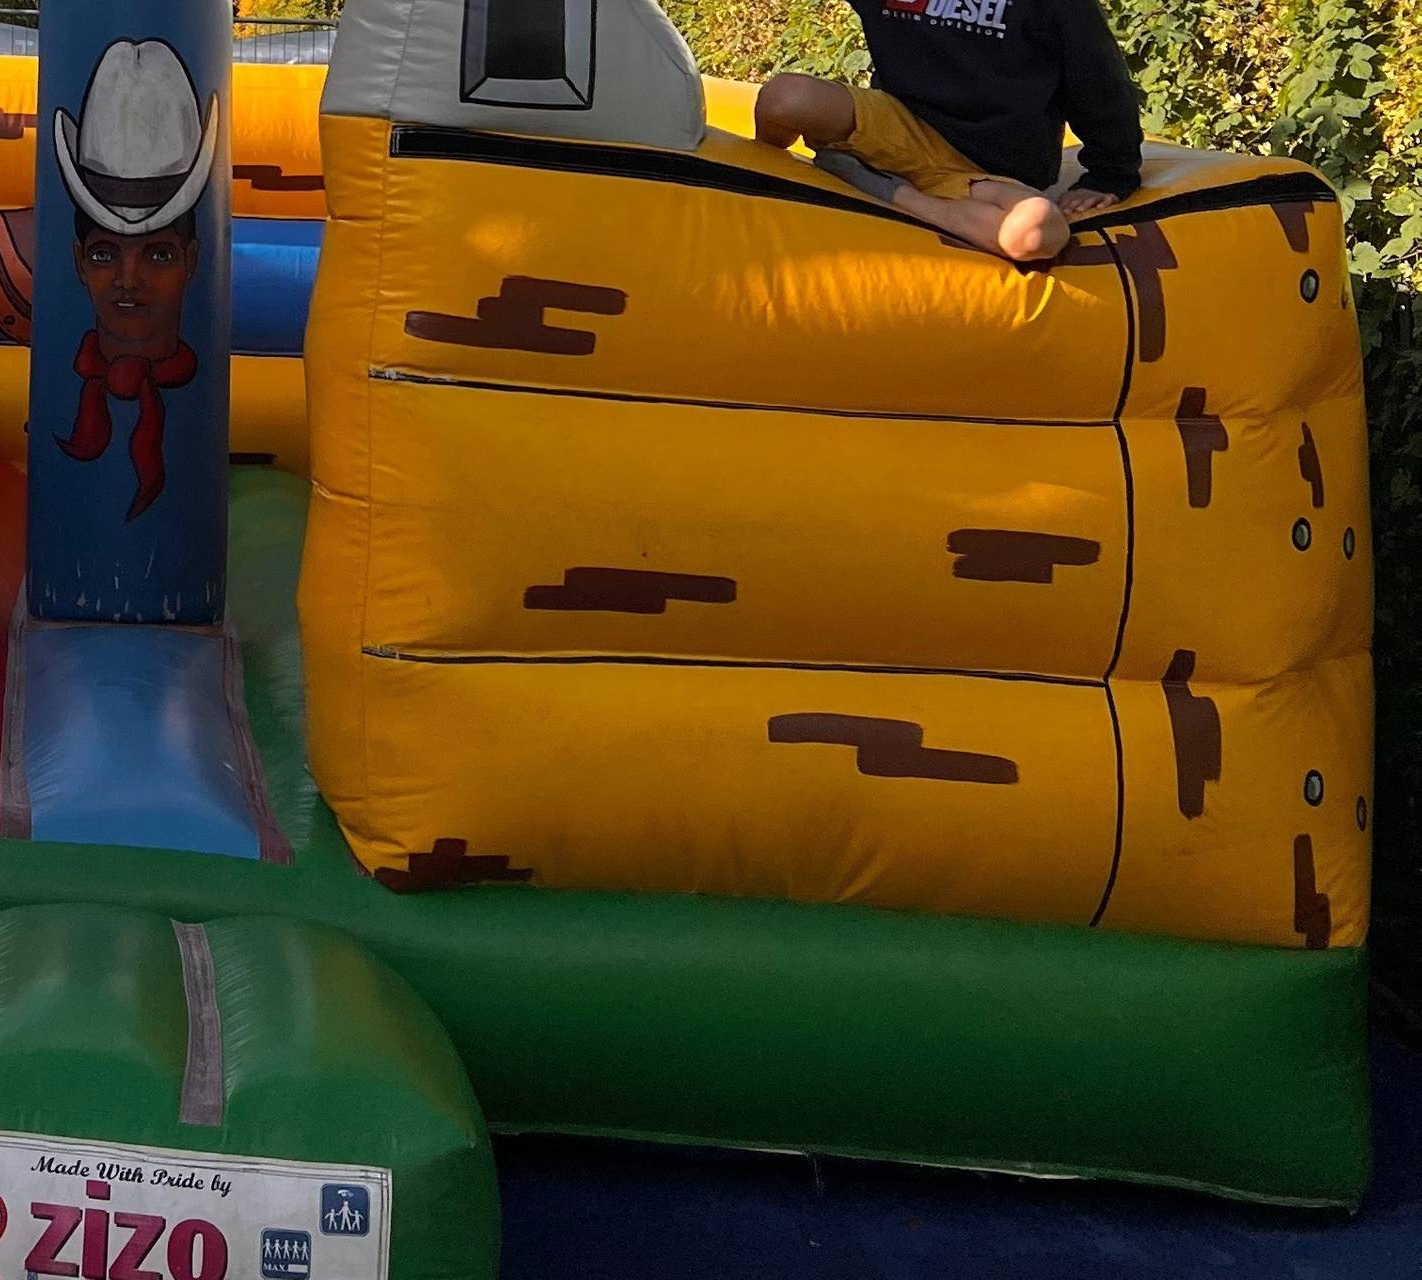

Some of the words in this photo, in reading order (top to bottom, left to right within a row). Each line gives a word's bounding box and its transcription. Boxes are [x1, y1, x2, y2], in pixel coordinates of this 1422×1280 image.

[31, 1156, 90, 1177] Made
[96, 1162, 145, 1184] With
[150, 1168, 205, 1190] Pride
[211, 1174, 233, 1197] by
